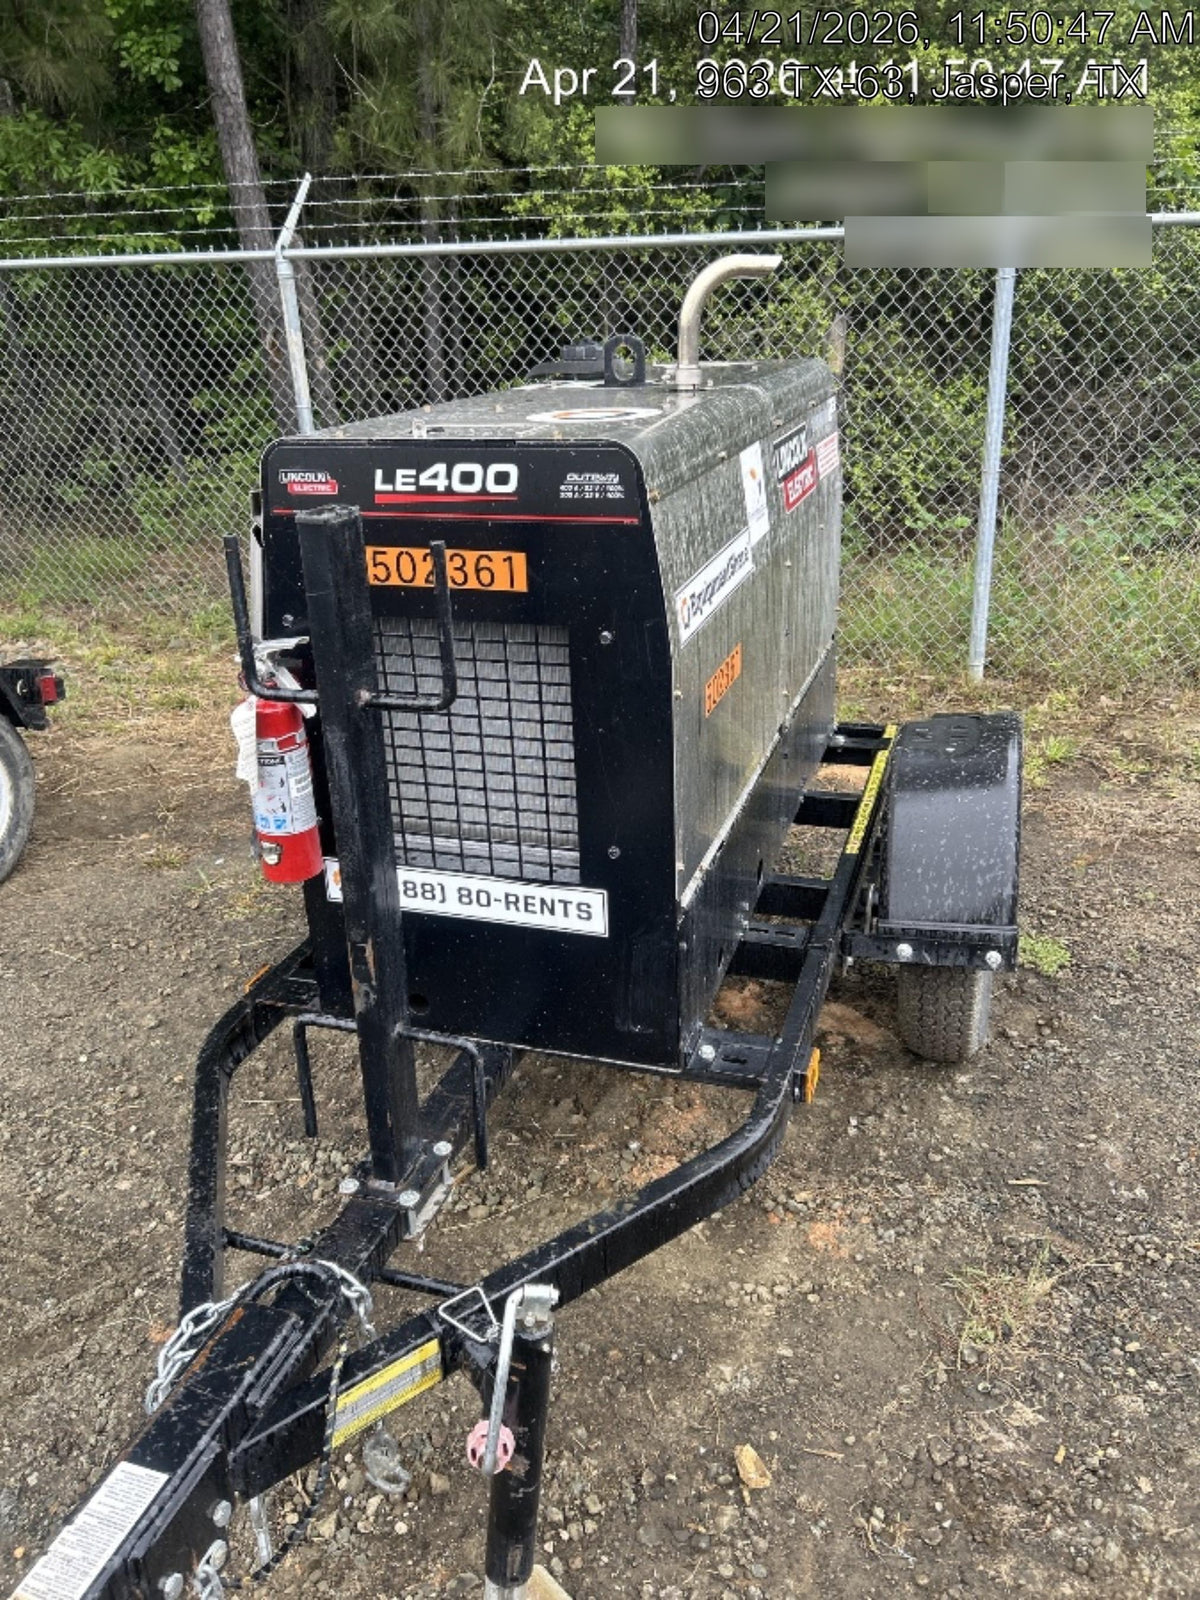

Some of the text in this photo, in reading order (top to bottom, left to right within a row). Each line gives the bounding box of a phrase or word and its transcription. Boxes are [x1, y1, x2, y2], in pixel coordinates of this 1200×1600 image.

[282, 472, 327, 483] LINCOLN
[374, 461, 519, 493] LE400
[372, 550, 515, 589] 502361
[456, 886, 593, 922] 80-RENTS
